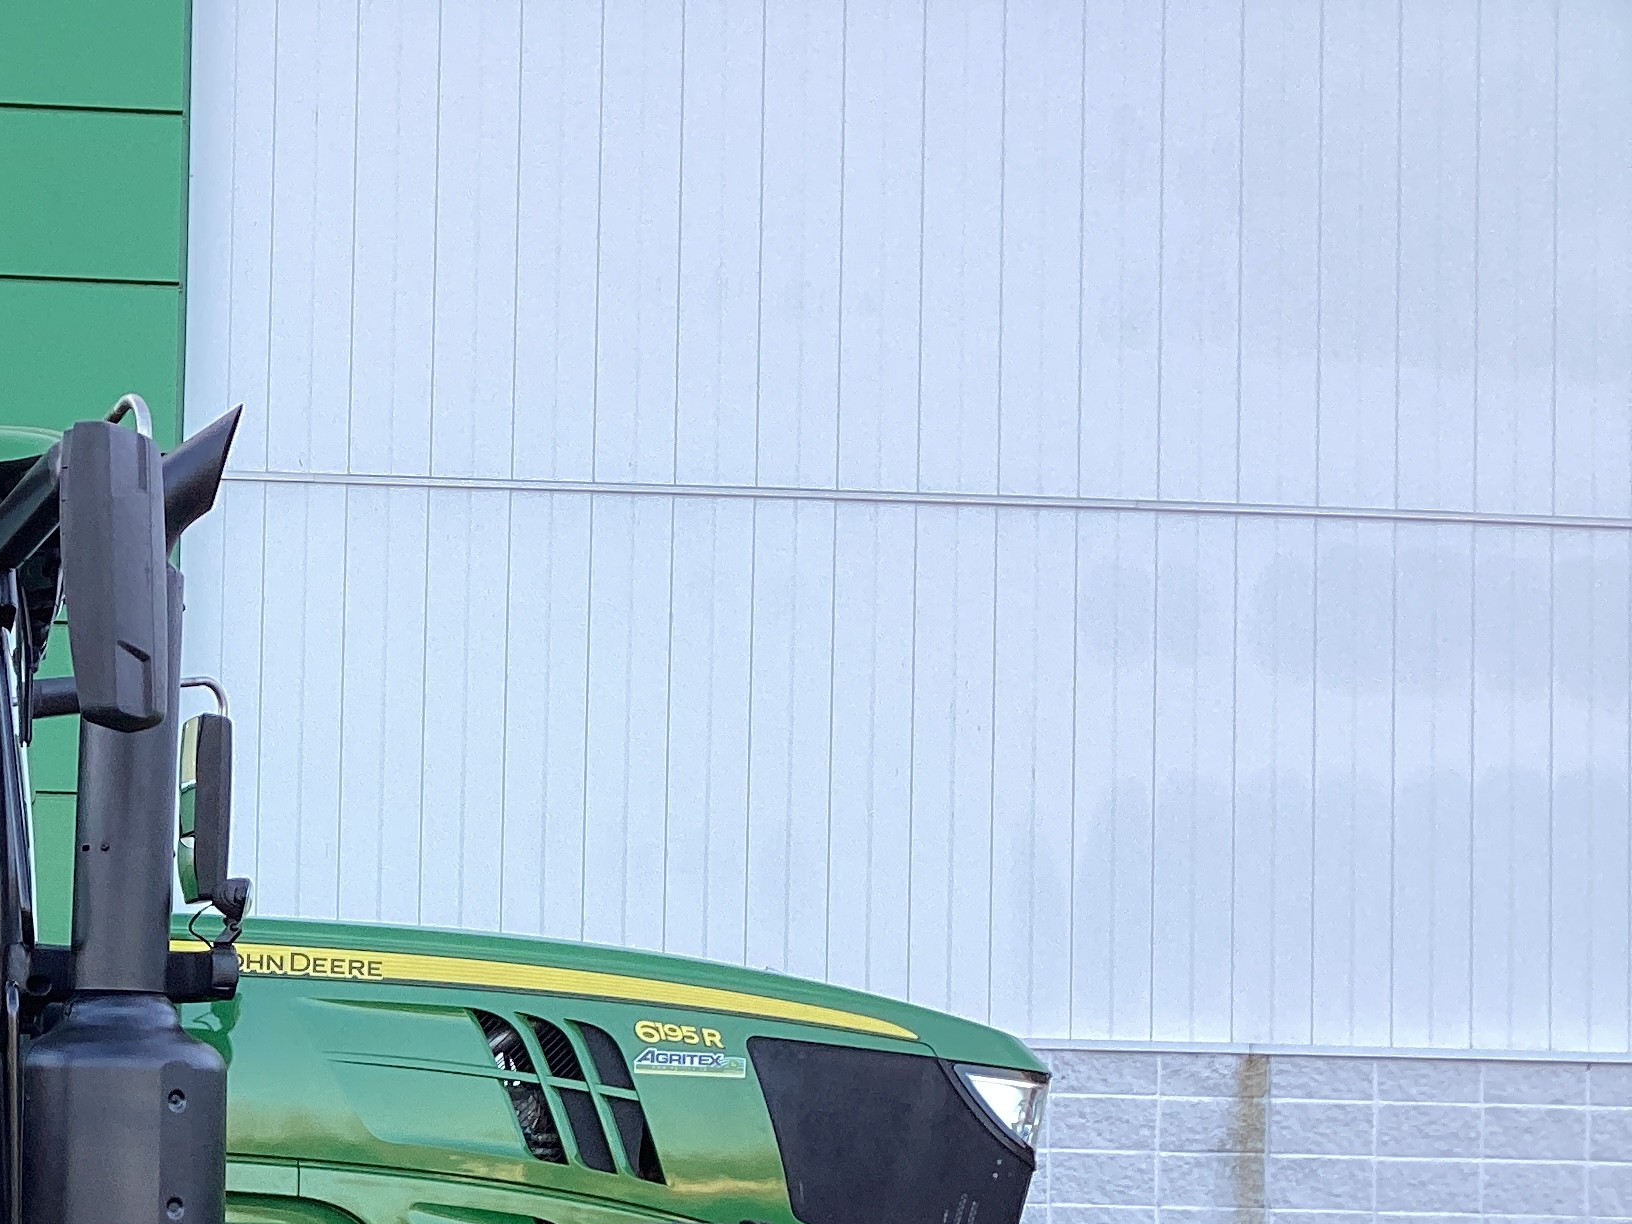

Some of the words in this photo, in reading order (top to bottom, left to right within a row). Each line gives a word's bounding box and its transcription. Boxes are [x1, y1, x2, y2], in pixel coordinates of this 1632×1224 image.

[290, 952, 383, 977] DEERE
[634, 1020, 700, 1045] 6195
[701, 1027, 726, 1049] R
[636, 1049, 723, 1067] AGRITEX
